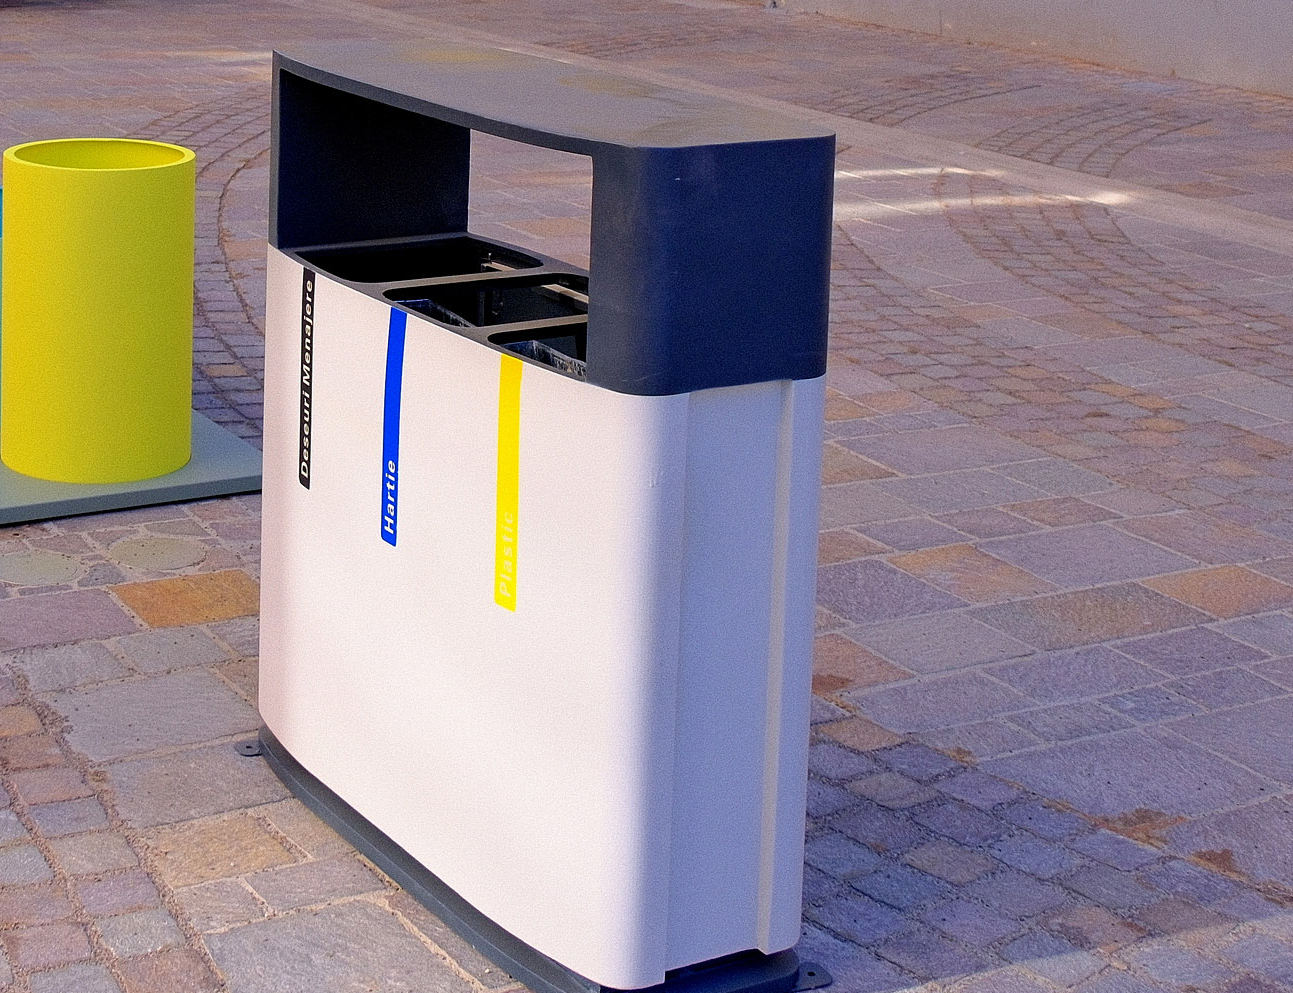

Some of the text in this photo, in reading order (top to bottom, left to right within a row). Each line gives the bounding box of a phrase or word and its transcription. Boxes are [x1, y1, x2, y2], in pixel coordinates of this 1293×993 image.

[300, 280, 313, 479] Deseuri Menajere
[384, 459, 396, 534] Hartie
[499, 512, 514, 598] Plastic
